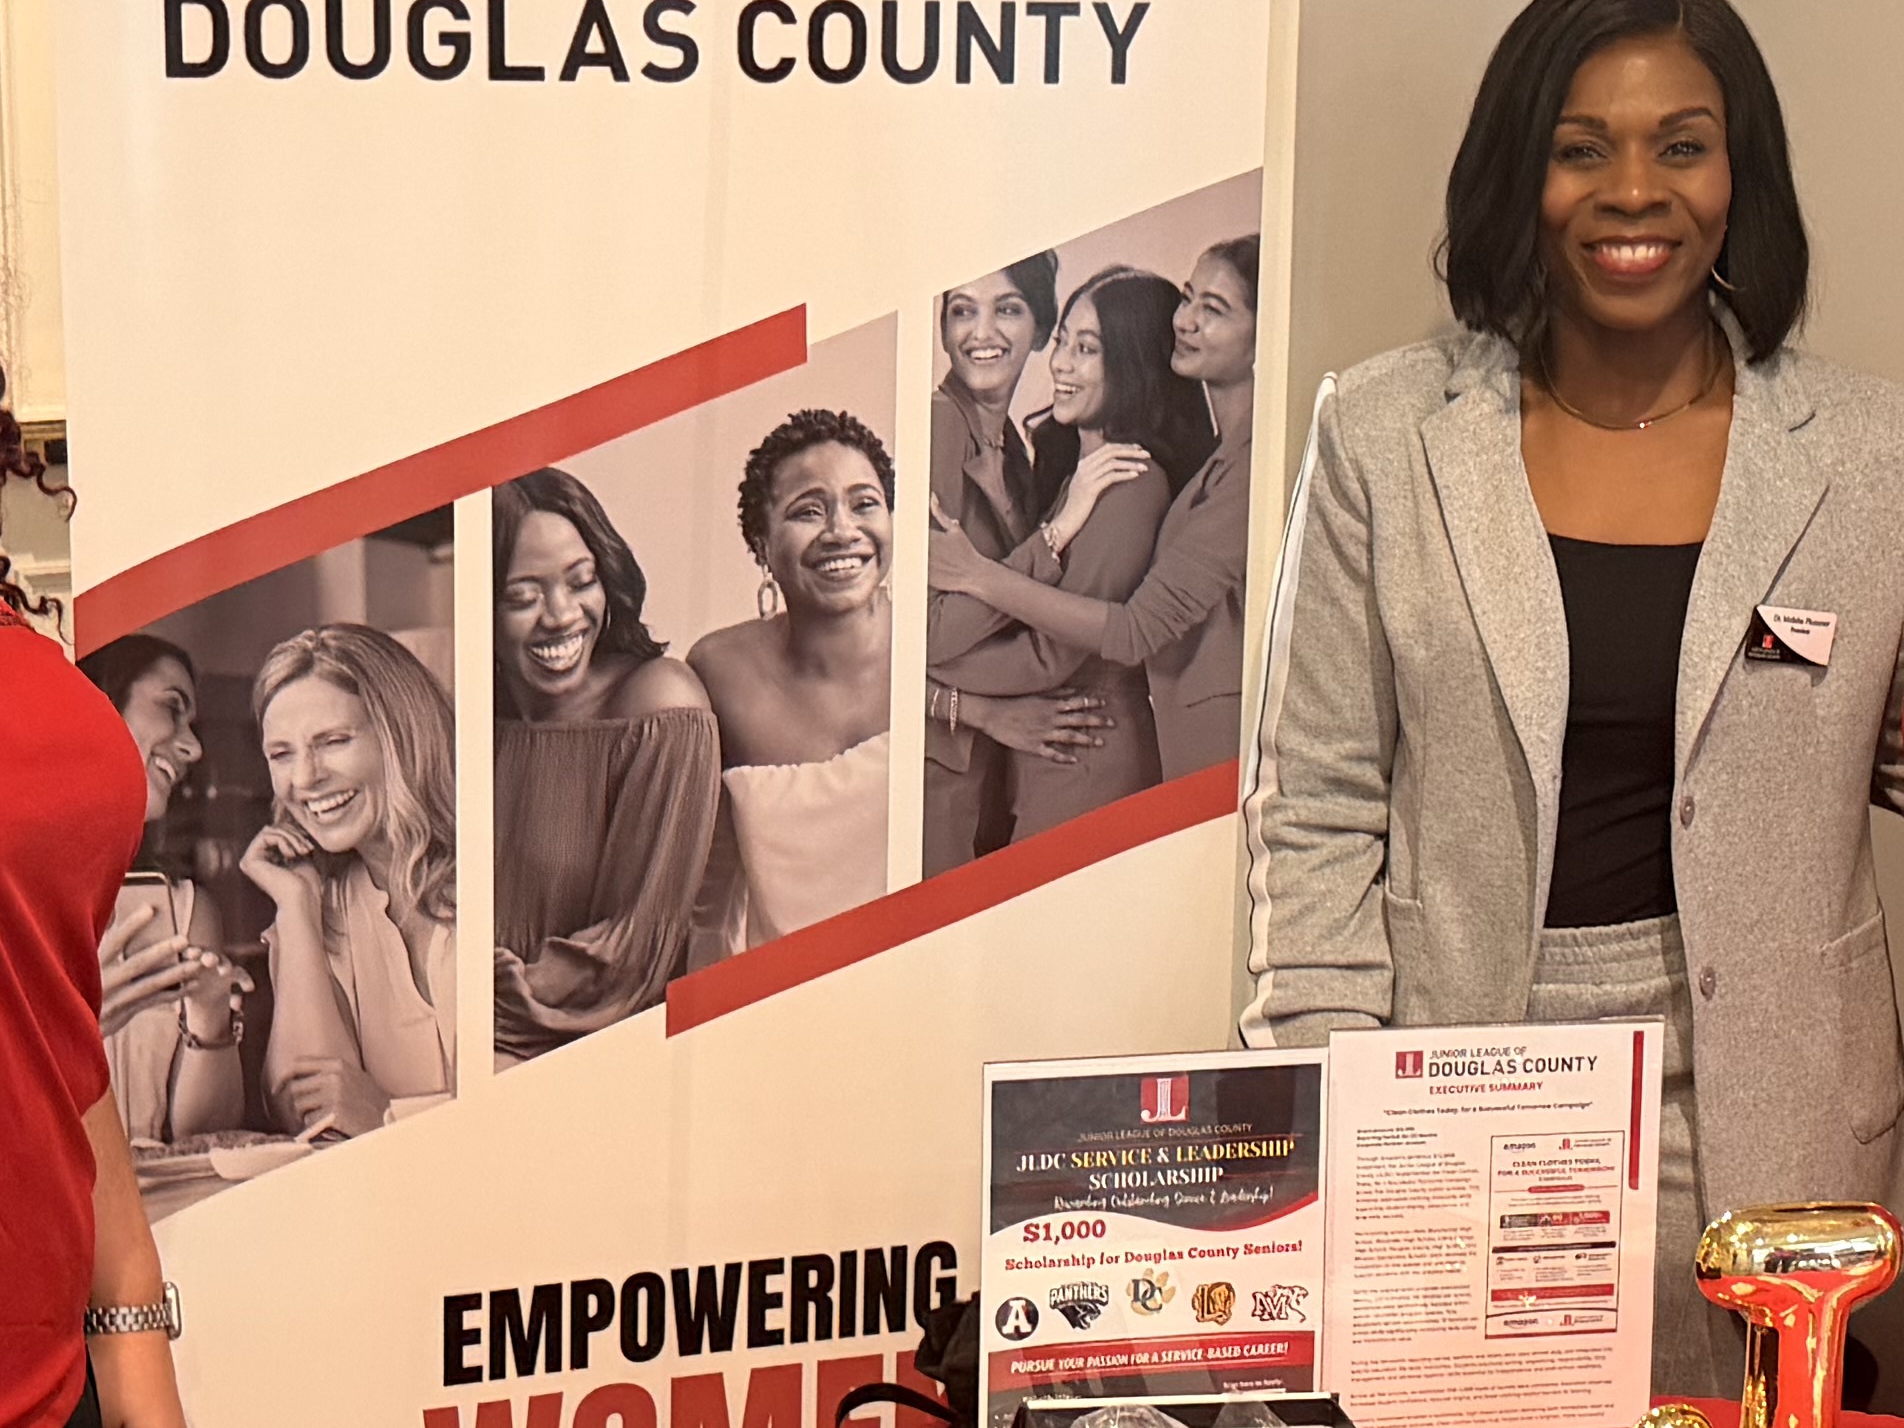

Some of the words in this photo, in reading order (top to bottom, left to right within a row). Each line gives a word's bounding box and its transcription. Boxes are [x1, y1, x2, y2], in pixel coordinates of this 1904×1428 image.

[1429, 1047, 1468, 1060] JUNIOR
[1469, 1046, 1512, 1059] LEAGUE
[1513, 1045, 1528, 1057] OF
[1428, 1057, 1519, 1078] DOUGLAS
[1522, 1055, 1598, 1074] COUNTY
[1429, 1084, 1487, 1096] EXECUTIVE
[1488, 1081, 1544, 1093] SUMMARY
[1153, 1127, 1166, 1139] OF
[1168, 1125, 1214, 1138] DOUGLAS
[1214, 1123, 1254, 1134] COUNTY
[1016, 1152, 1067, 1172] JLDC
[1070, 1147, 1154, 1169] SERVICE
[1156, 1145, 1171, 1164] &
[1175, 1138, 1296, 1163] LEADERSHIP
[1088, 1165, 1225, 1191] SCHOLARSHIP
[1004, 1252, 1097, 1272] Scholarship
[1099, 1251, 1122, 1267] for
[1123, 1248, 1185, 1266] Douglas
[1186, 1245, 1240, 1262] County
[1242, 1239, 1304, 1257] Seniors!
[1048, 1280, 1110, 1307] PANTHERS
[442, 1239, 959, 1387] EMPOWERING
[1000, 1299, 1034, 1336] A
[1010, 1358, 1056, 1374] PURSUE
[1058, 1357, 1086, 1371] YOUR
[1130, 1352, 1150, 1366] FOR
[1150, 1351, 1160, 1364] A
